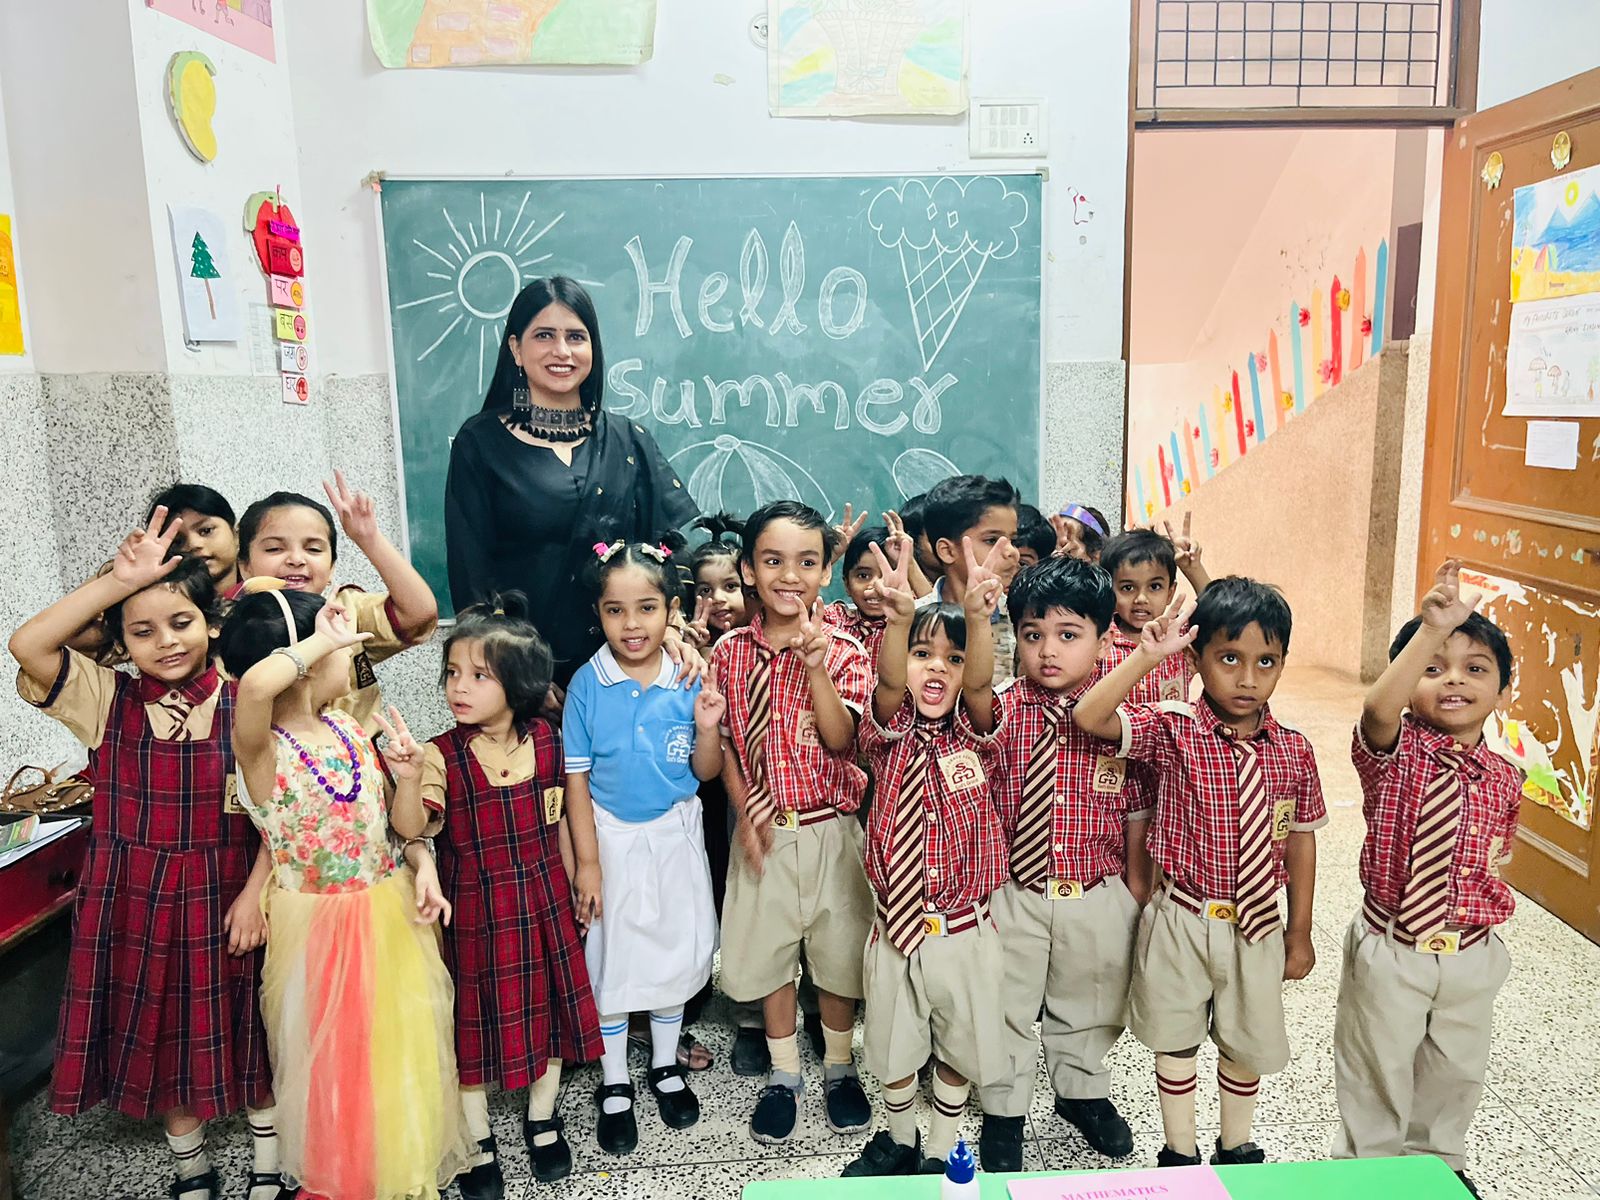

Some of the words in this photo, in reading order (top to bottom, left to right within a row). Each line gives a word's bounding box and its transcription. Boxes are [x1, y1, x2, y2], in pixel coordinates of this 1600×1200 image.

[274, 279, 289, 297] पर
[624, 220, 868, 340] Hello
[1061, 1184, 1169, 1200] MATHEMATICS
